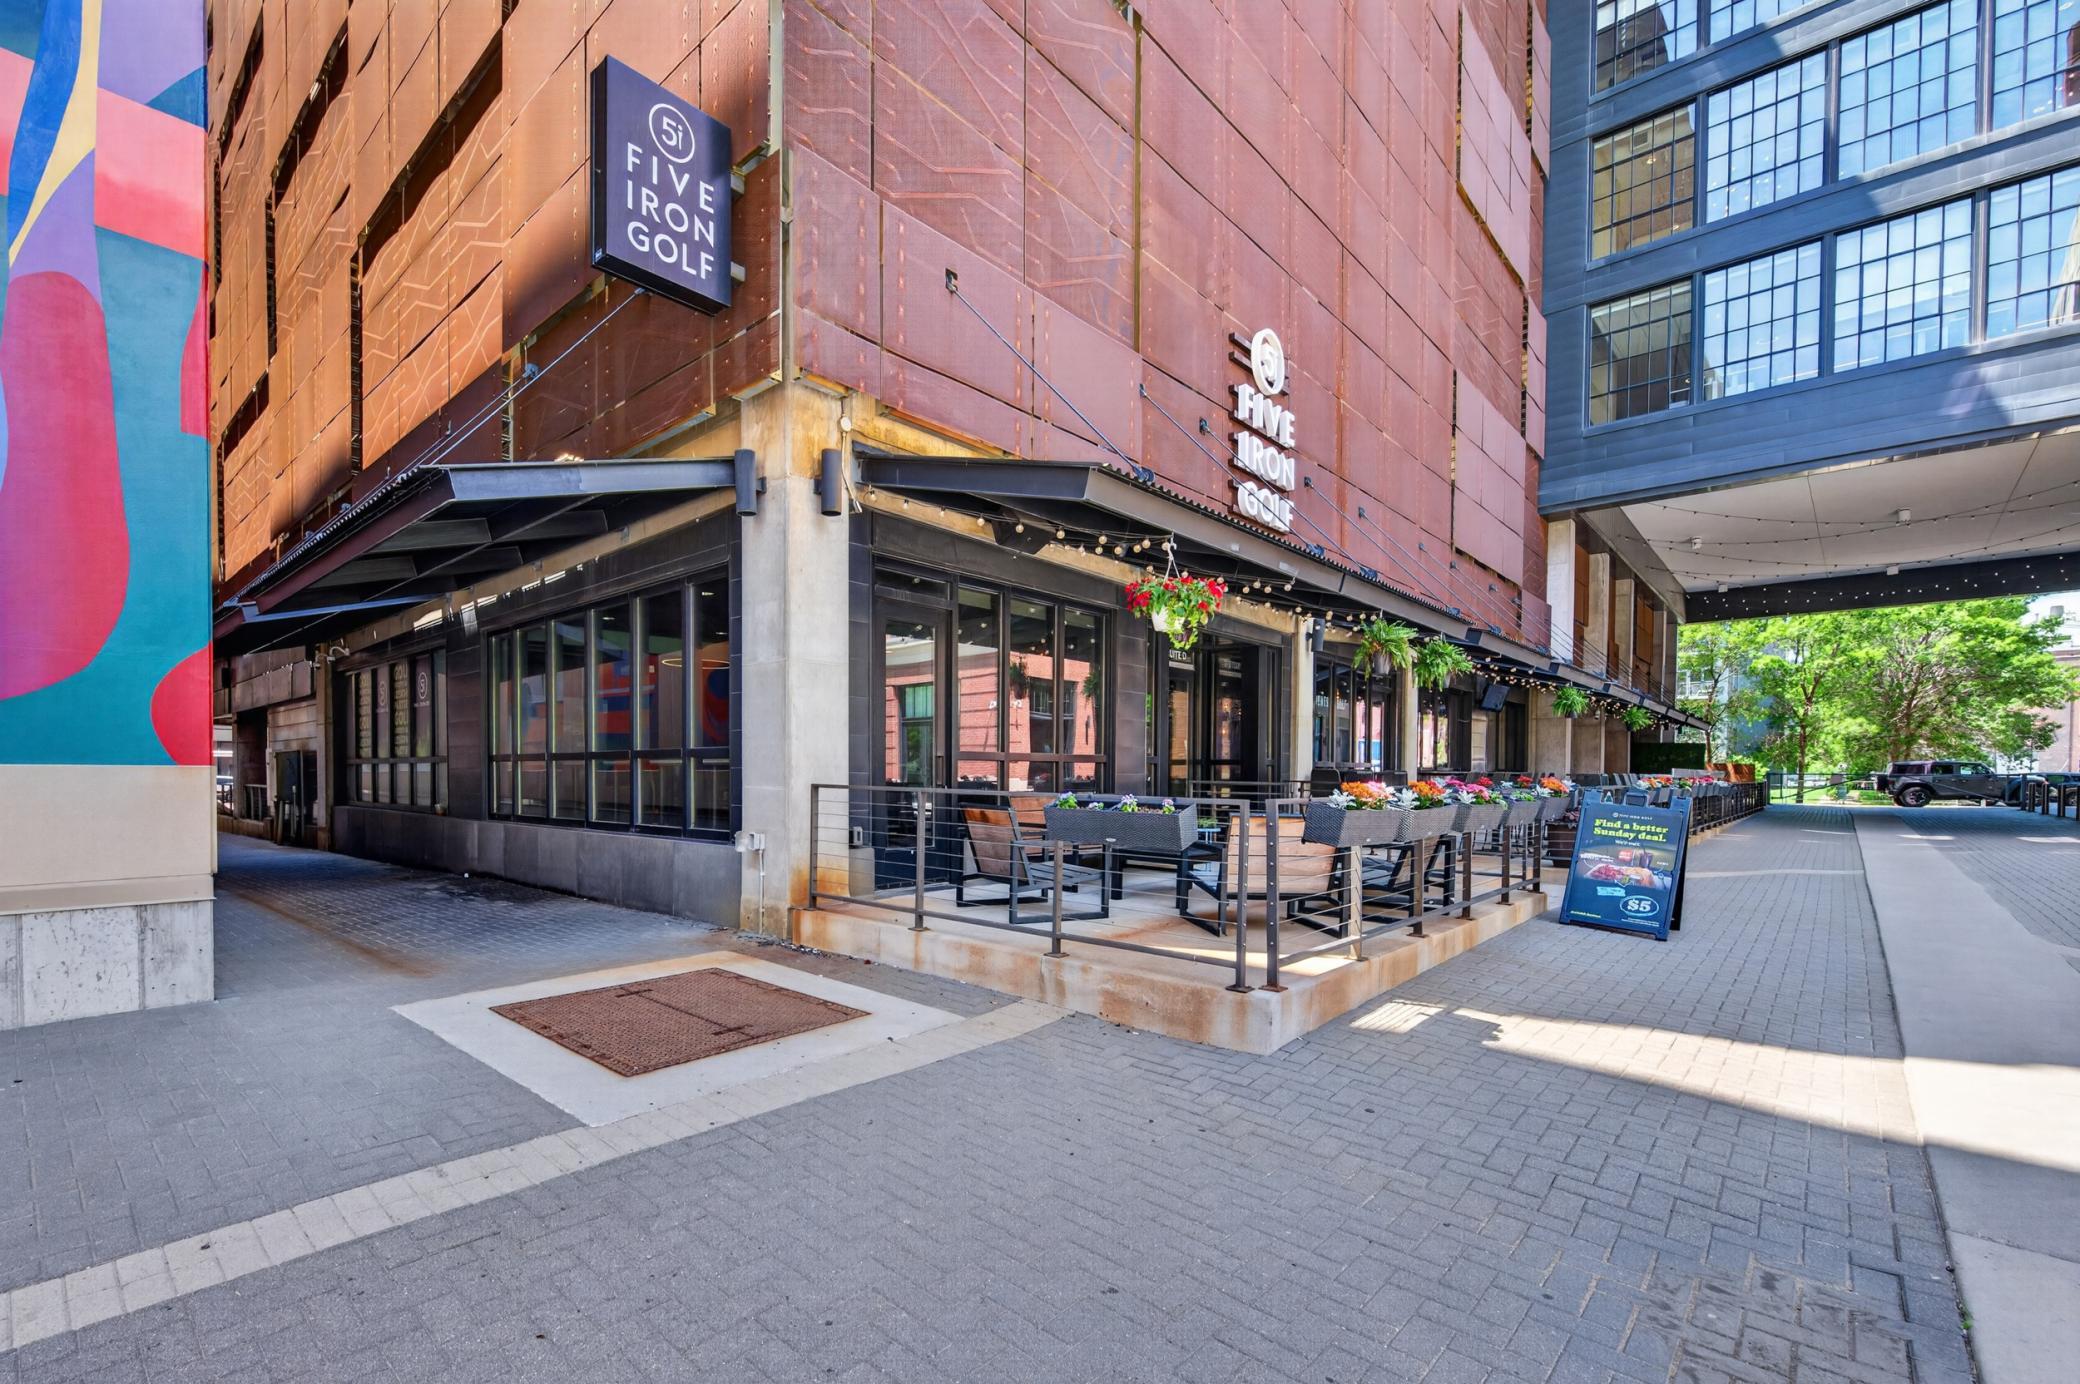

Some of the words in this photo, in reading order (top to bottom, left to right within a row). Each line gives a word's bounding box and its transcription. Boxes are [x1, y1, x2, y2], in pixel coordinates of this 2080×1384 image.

[627, 142, 714, 214] FIVE
[627, 179, 714, 248] IRON
[627, 221, 714, 280] GOLF
[1237, 383, 1295, 449] FIVE
[1237, 430, 1295, 491] IRON
[1237, 481, 1295, 533] GOLF
[1593, 827, 1636, 840] Sunday
[1638, 832, 1666, 842] deal.
[1594, 819, 1621, 828] Find
[1632, 822, 1668, 833] better
[1627, 899, 1651, 912] $5
